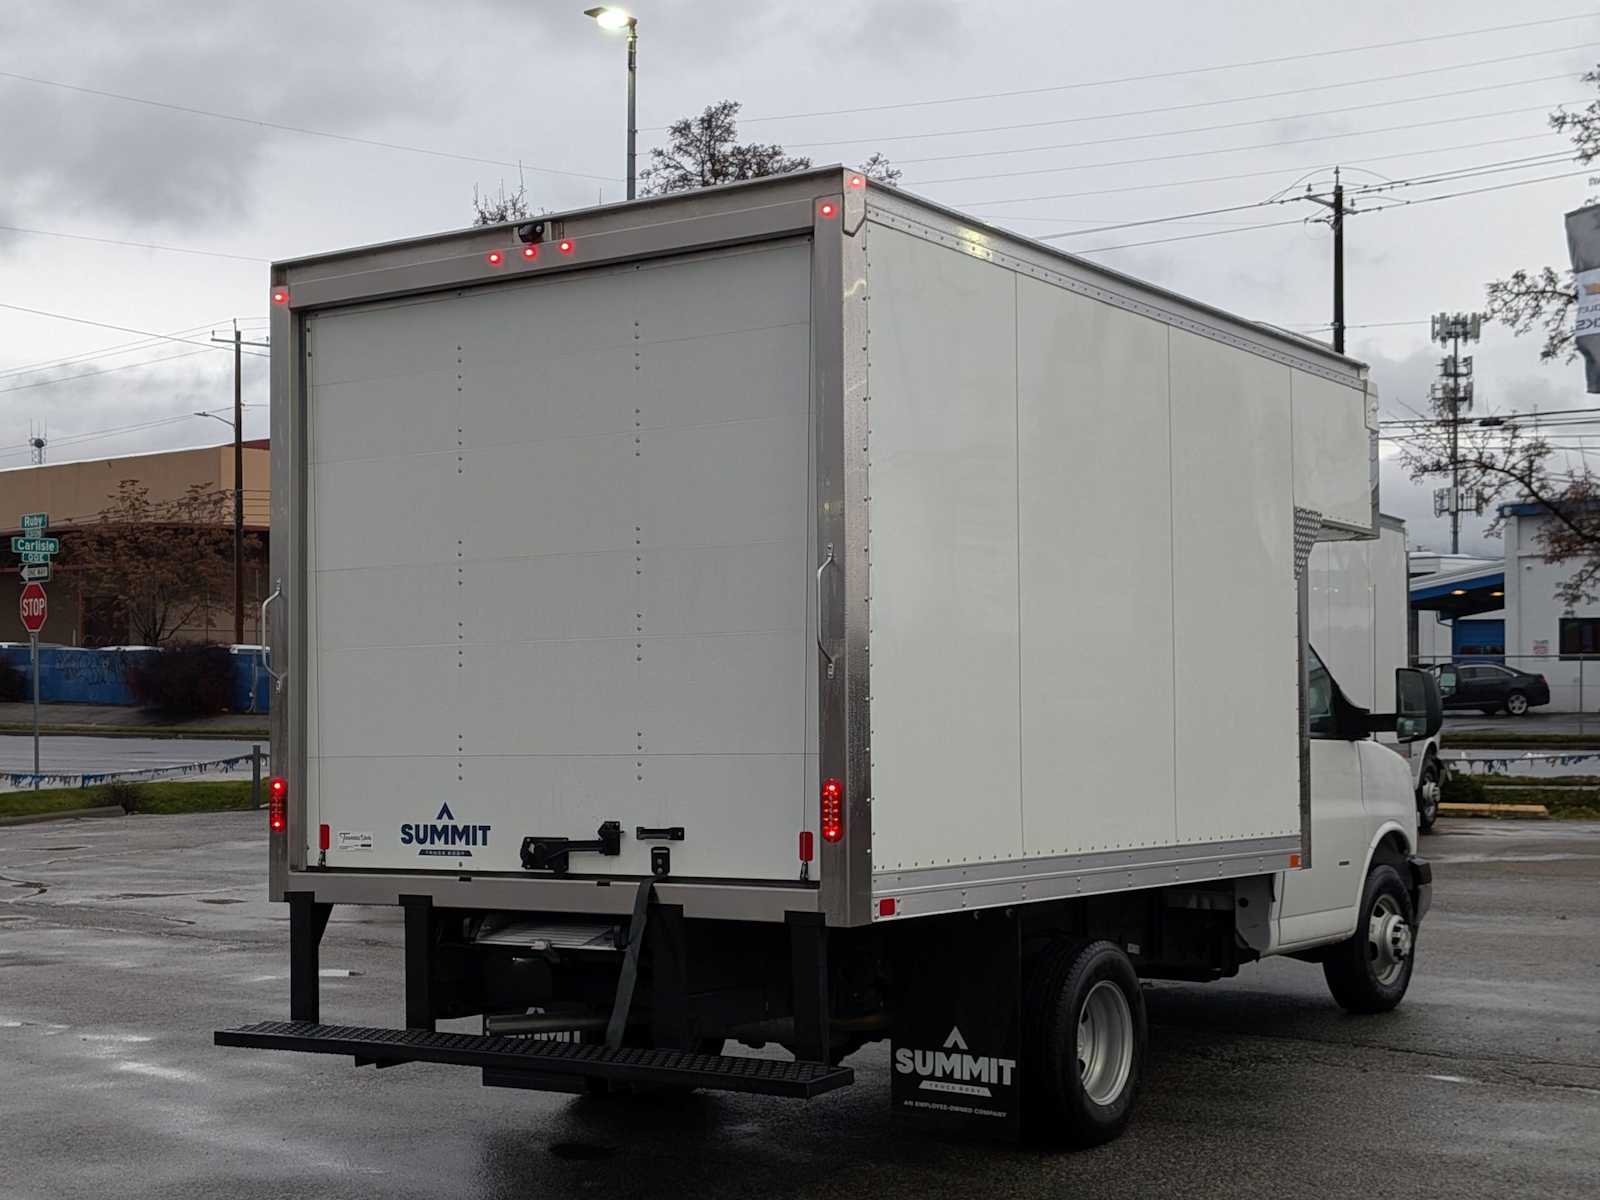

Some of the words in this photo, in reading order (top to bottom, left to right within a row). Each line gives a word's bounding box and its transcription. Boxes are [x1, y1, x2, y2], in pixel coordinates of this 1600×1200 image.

[24, 516, 43, 528] Ruby
[17, 539, 55, 551] Carlisle
[22, 598, 45, 616] STOP
[401, 824, 491, 846] SUMMIT
[895, 1048, 1016, 1086] SUMMIT
